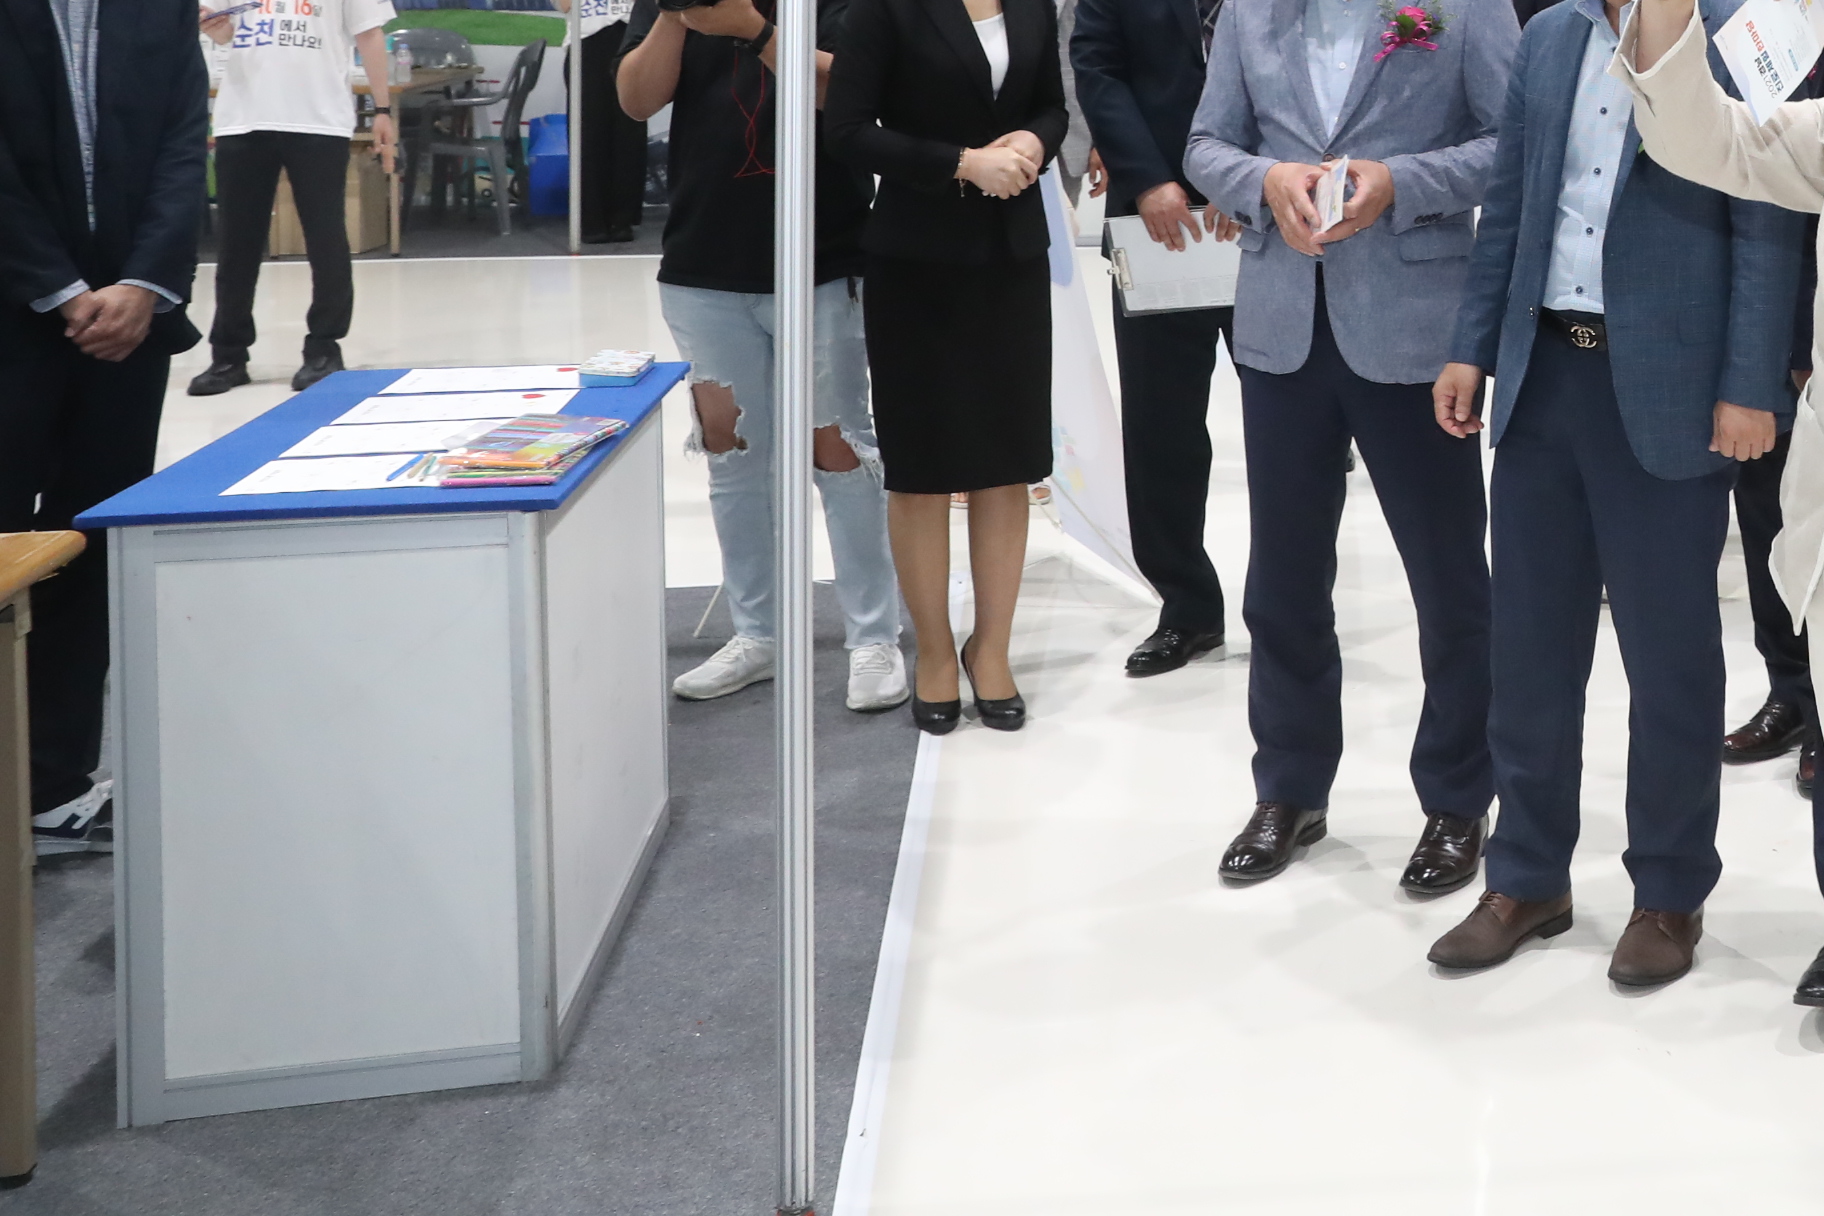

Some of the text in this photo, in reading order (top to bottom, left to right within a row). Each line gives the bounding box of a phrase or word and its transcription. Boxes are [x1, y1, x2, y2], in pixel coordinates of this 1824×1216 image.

[232, 17, 307, 49] 순천 에서
[278, 34, 322, 50] 만나요!
